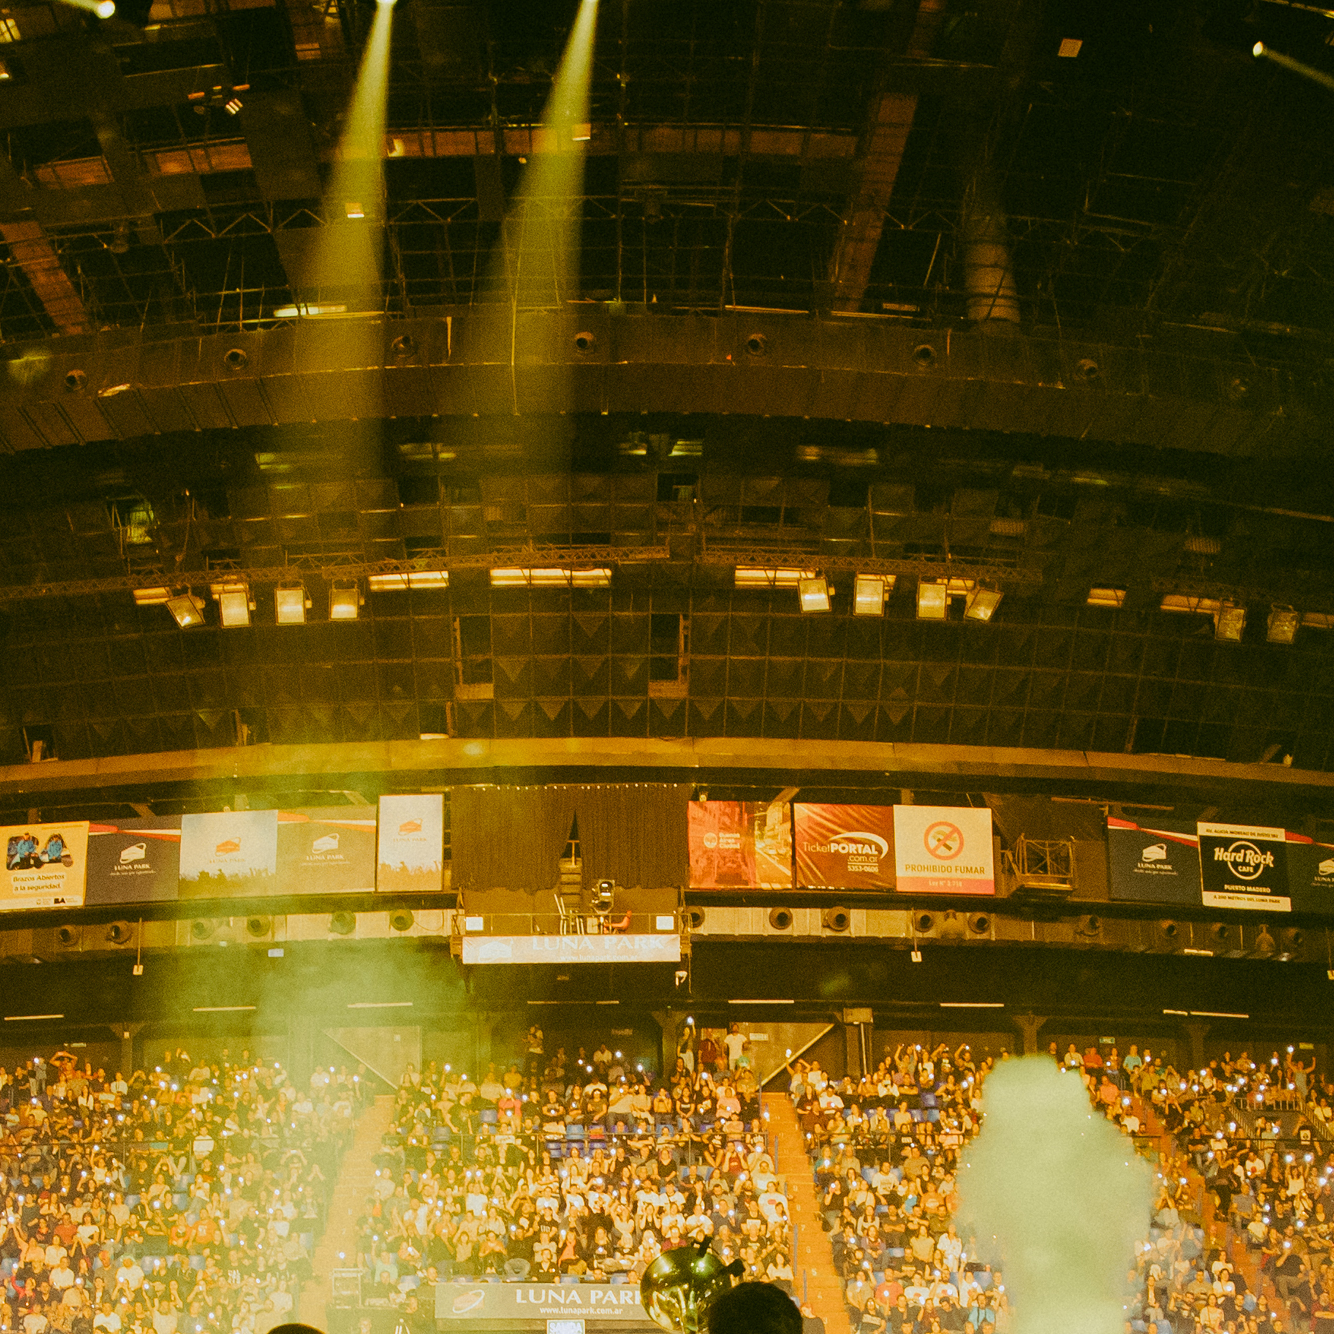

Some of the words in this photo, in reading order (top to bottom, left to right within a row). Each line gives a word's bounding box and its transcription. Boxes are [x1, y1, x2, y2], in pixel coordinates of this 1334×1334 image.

[1214, 846, 1245, 862] Hard
[1245, 849, 1275, 868] Rock
[905, 864, 953, 874] PROHIBIDO
[955, 866, 985, 874] FUMAR
[1247, 885, 1271, 893] MADERO
[532, 936, 593, 950] LUNA
[604, 936, 665, 950] PARK
[516, 1289, 582, 1304] LUNA
[539, 1306, 623, 1316] www.lunapark.com.ar
